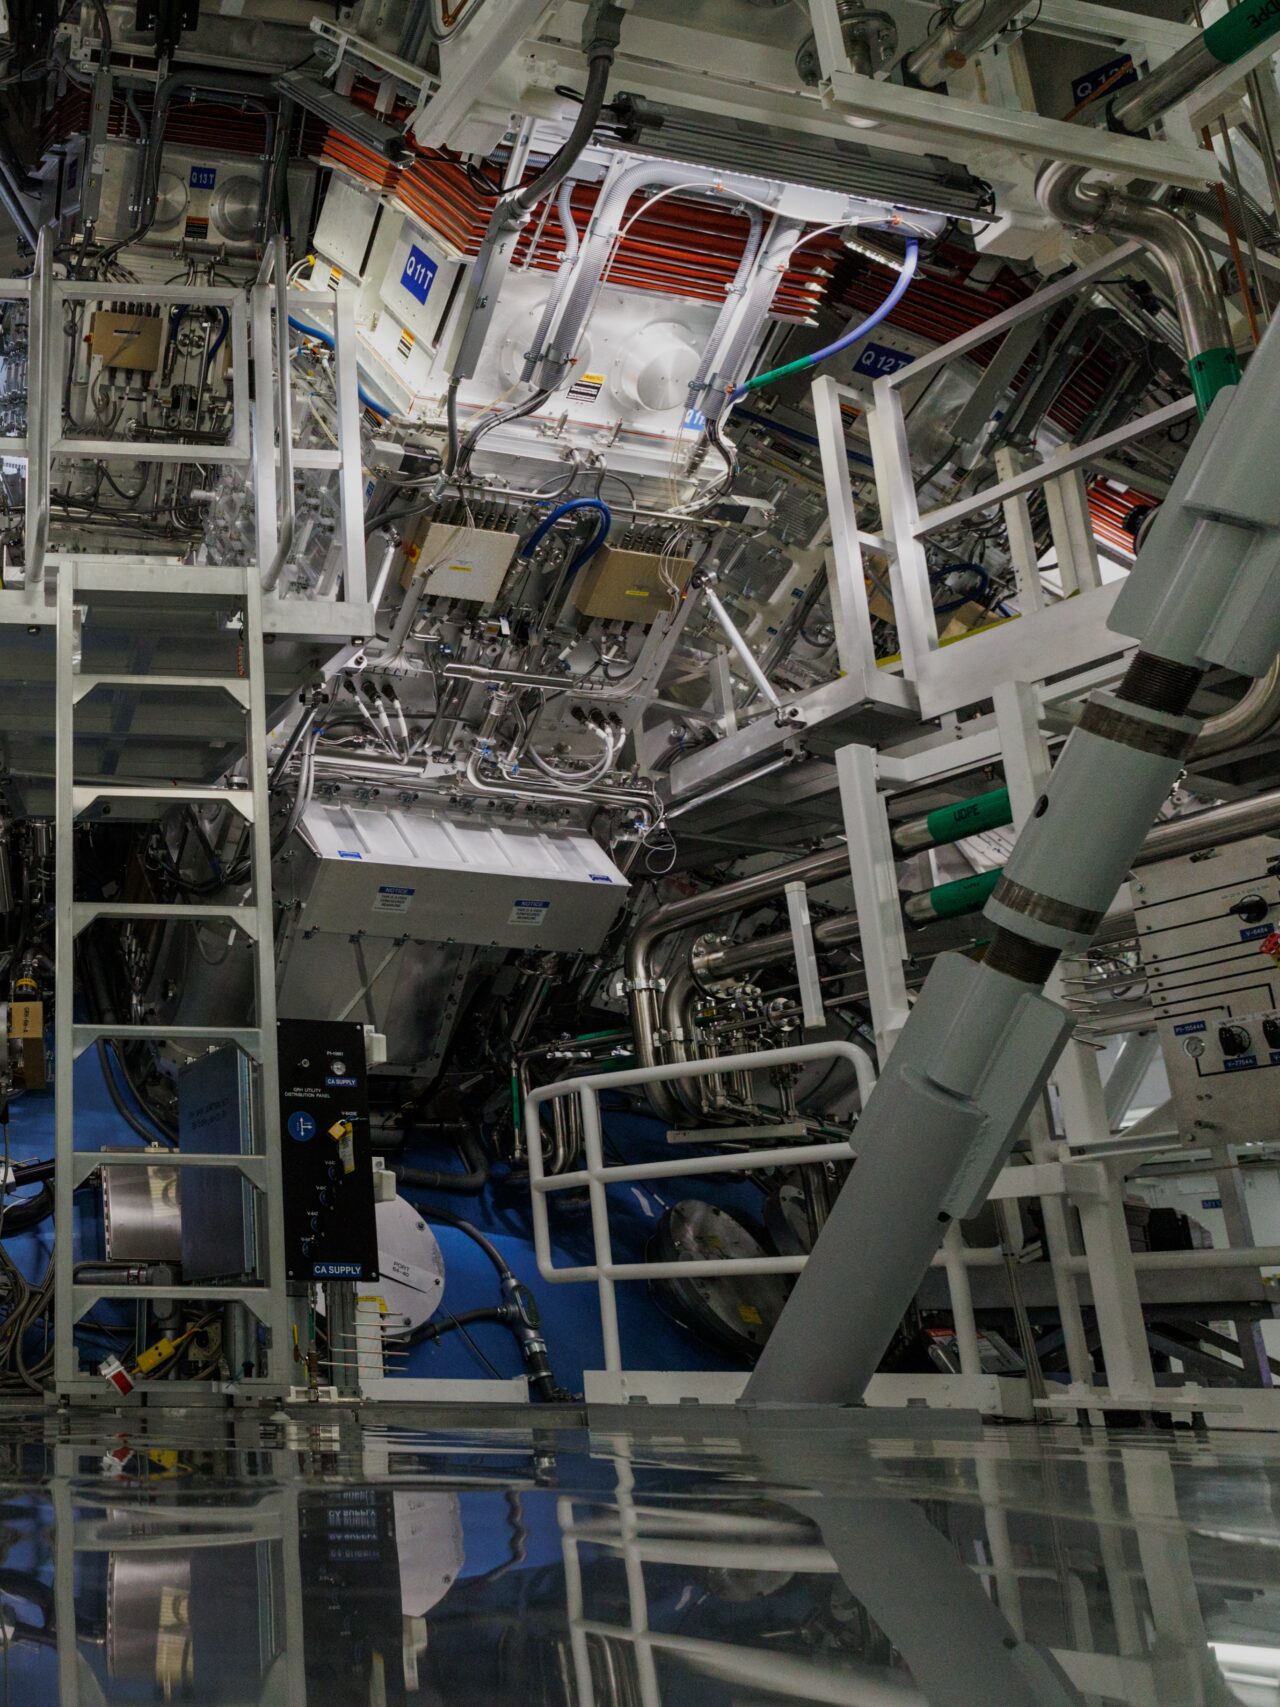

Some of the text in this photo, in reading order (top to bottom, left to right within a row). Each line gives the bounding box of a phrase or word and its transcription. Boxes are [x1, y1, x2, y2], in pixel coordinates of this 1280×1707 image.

[1076, 82, 1093, 97] Q
[192, 172, 197, 183] Q
[209, 174, 214, 184] T
[406, 256, 433, 290] Q 11 T
[862, 351, 875, 366] Q
[877, 356, 895, 371] 12
[685, 411, 692, 424] Q
[314, 1266, 361, 1274] CA SUPPLY
[393, 1261, 410, 1271] PORT
